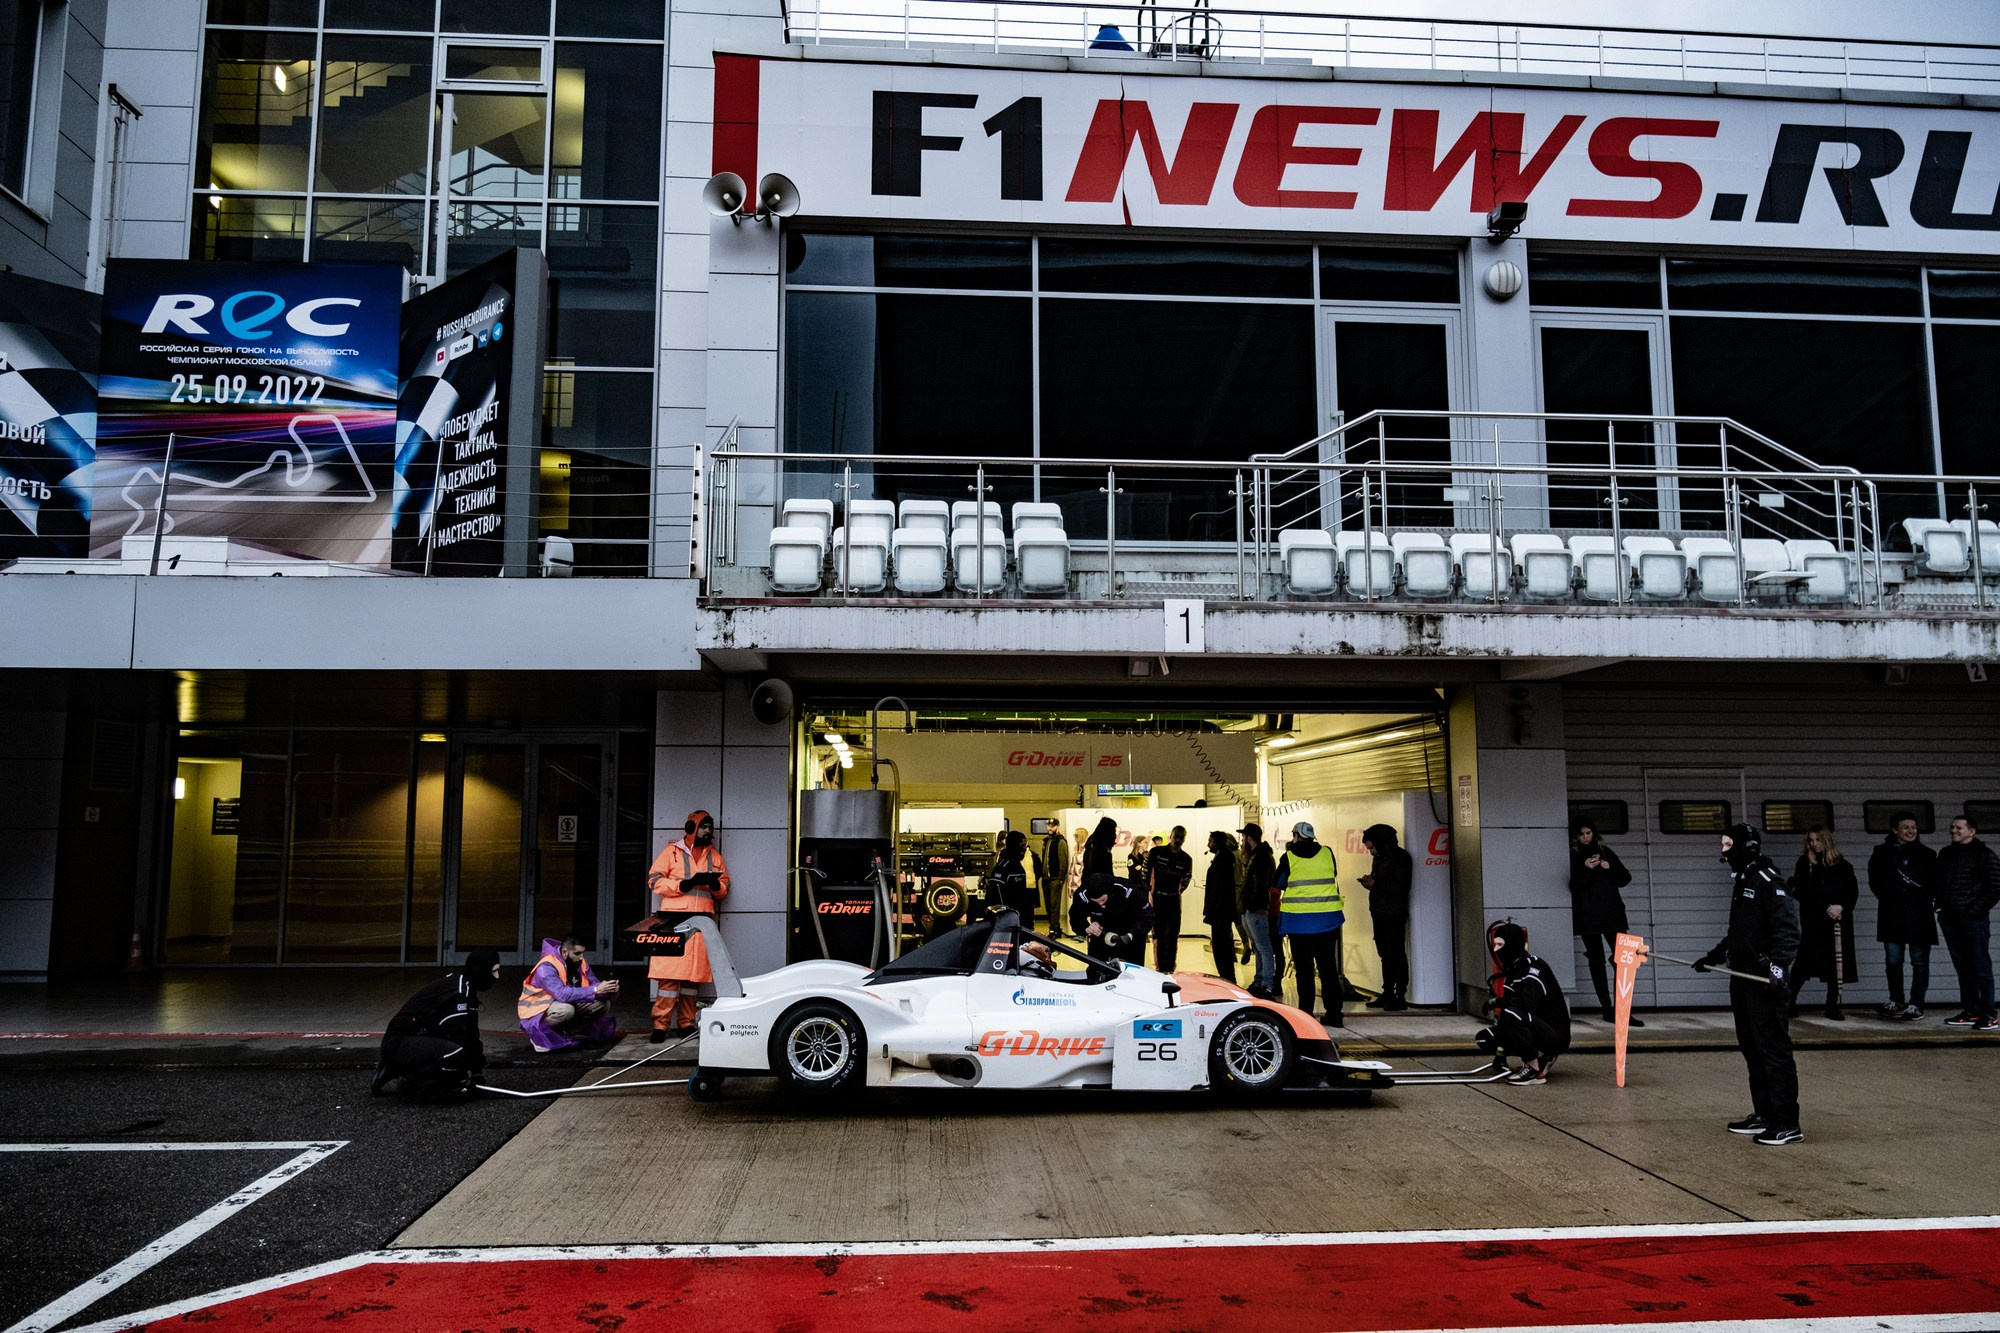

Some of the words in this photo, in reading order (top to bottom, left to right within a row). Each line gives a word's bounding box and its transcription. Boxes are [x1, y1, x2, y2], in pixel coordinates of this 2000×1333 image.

[139, 344, 199, 353] РОССИЙСКАЯ
[286, 347, 359, 356] ВЫНОСЛИВОСТЬ
[167, 356, 224, 364] ЧЕМПИОНАТ
[225, 357, 288, 366] МОСКОВСКОЙ
[290, 359, 331, 367] ОБЛАСТИ
[170, 373, 326, 405] 25.09.2022
[455, 485, 496, 514] ТЕХНИКИ
[168, 554, 182, 570] 1
[1179, 607, 1190, 644] 1
[1970, 662, 1983, 680] 2
[1097, 755, 1123, 767] 26
[1620, 950, 1634, 965] 26
[1137, 1042, 1178, 1061] 26
